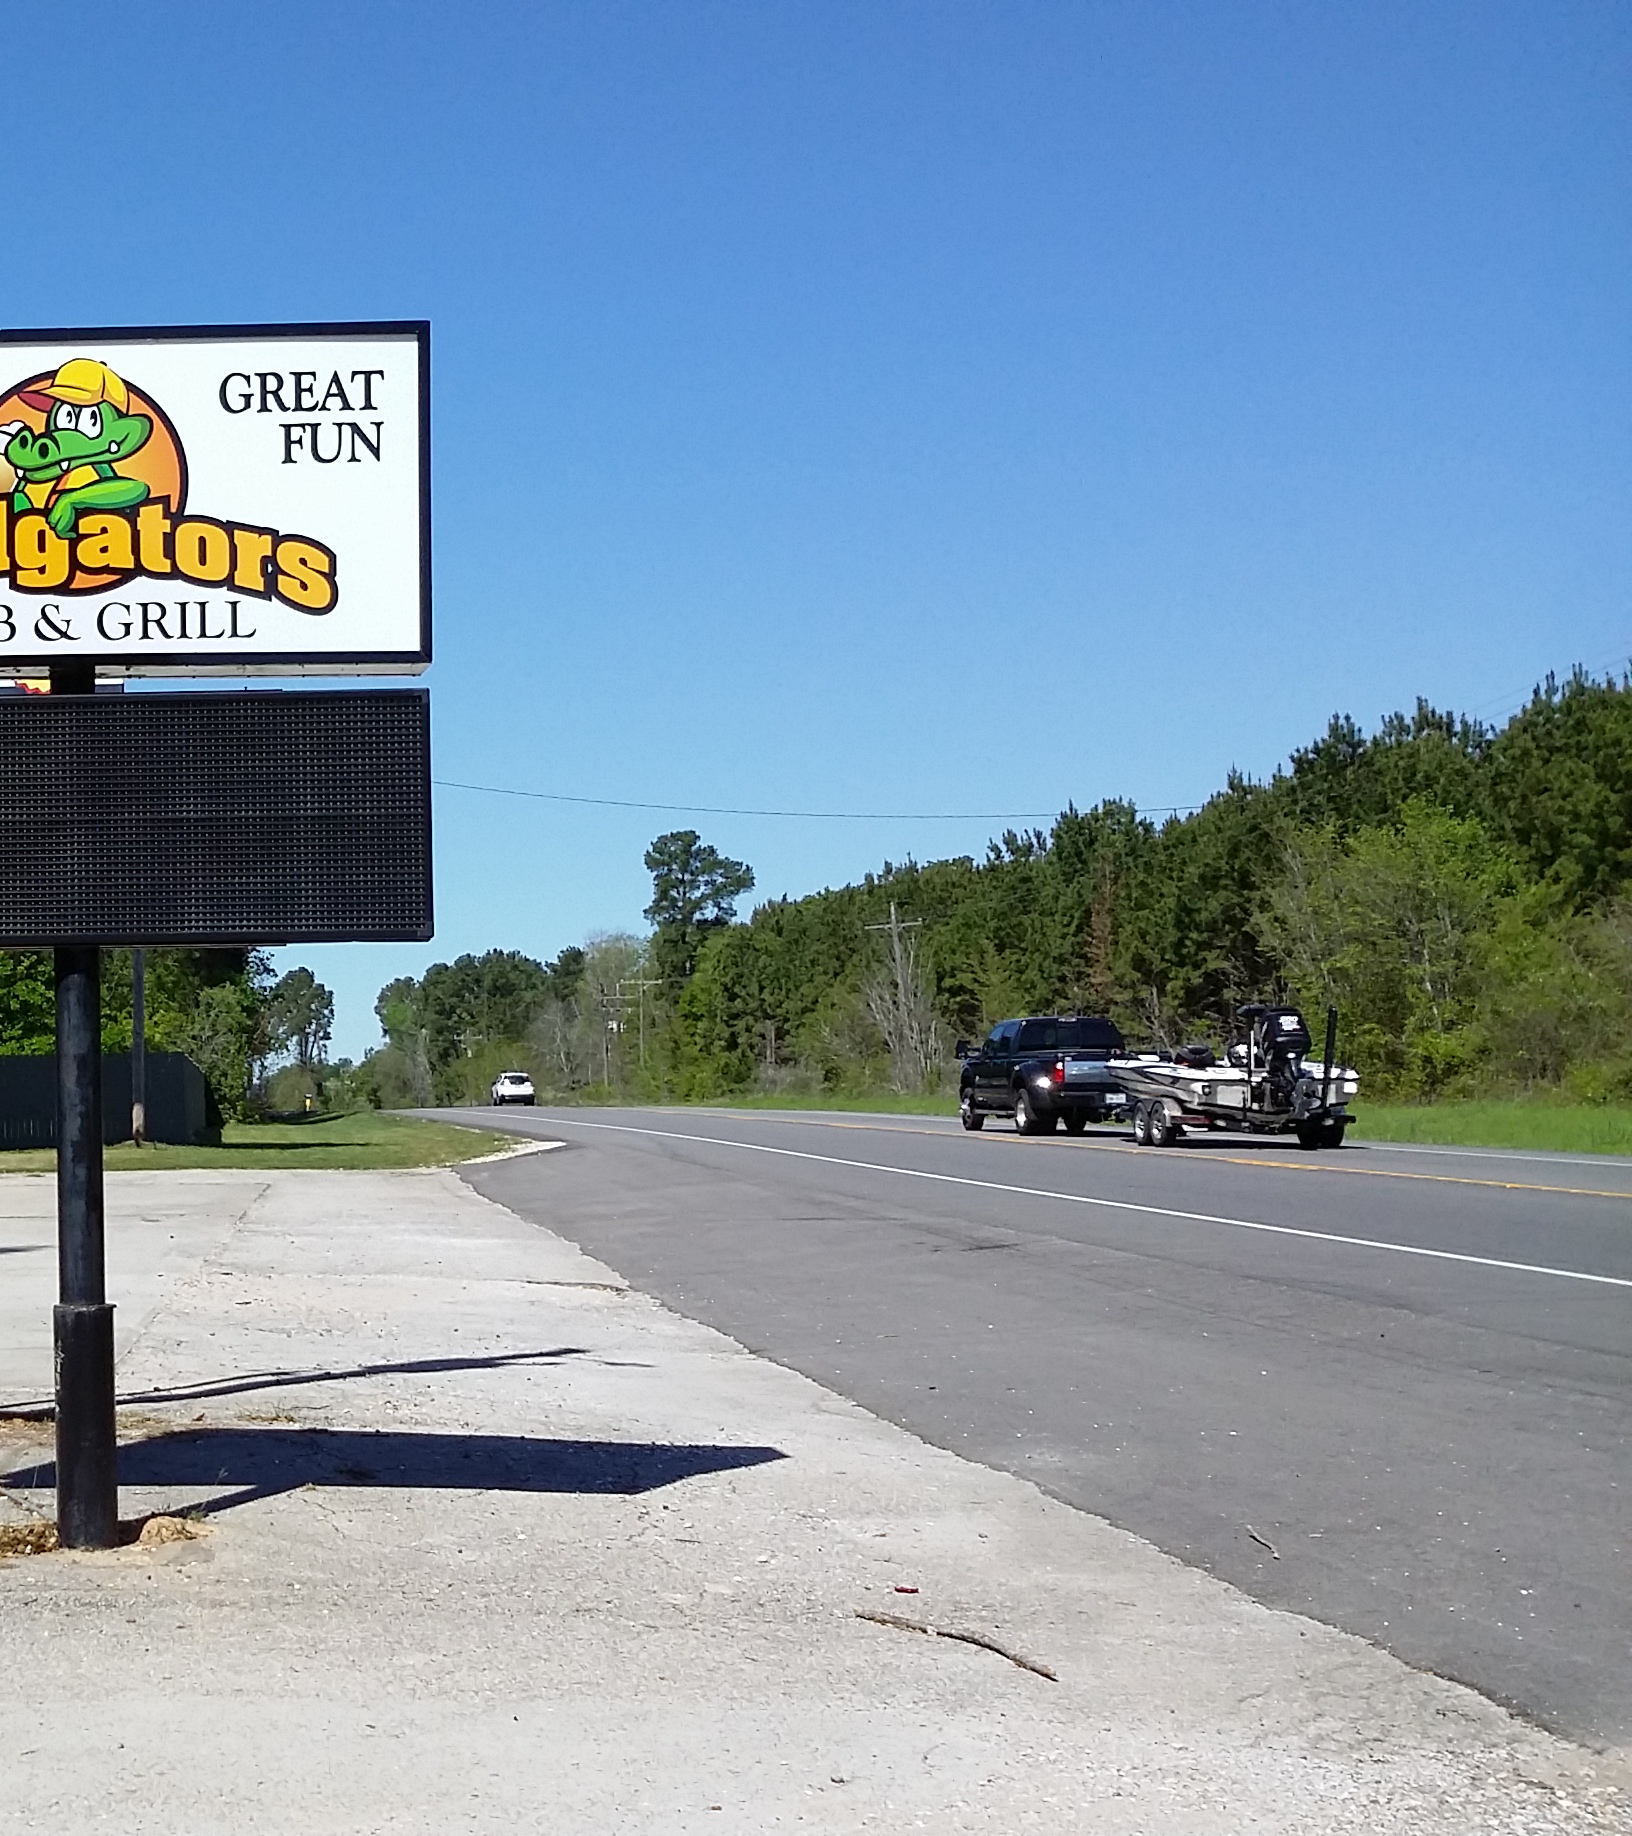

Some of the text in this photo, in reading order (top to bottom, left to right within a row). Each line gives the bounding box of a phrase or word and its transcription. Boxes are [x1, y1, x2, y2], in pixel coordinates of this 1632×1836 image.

[219, 369, 385, 415] GREAT
[279, 421, 384, 465] FUN
[34, 602, 81, 642] &
[95, 600, 257, 640] GRILL
